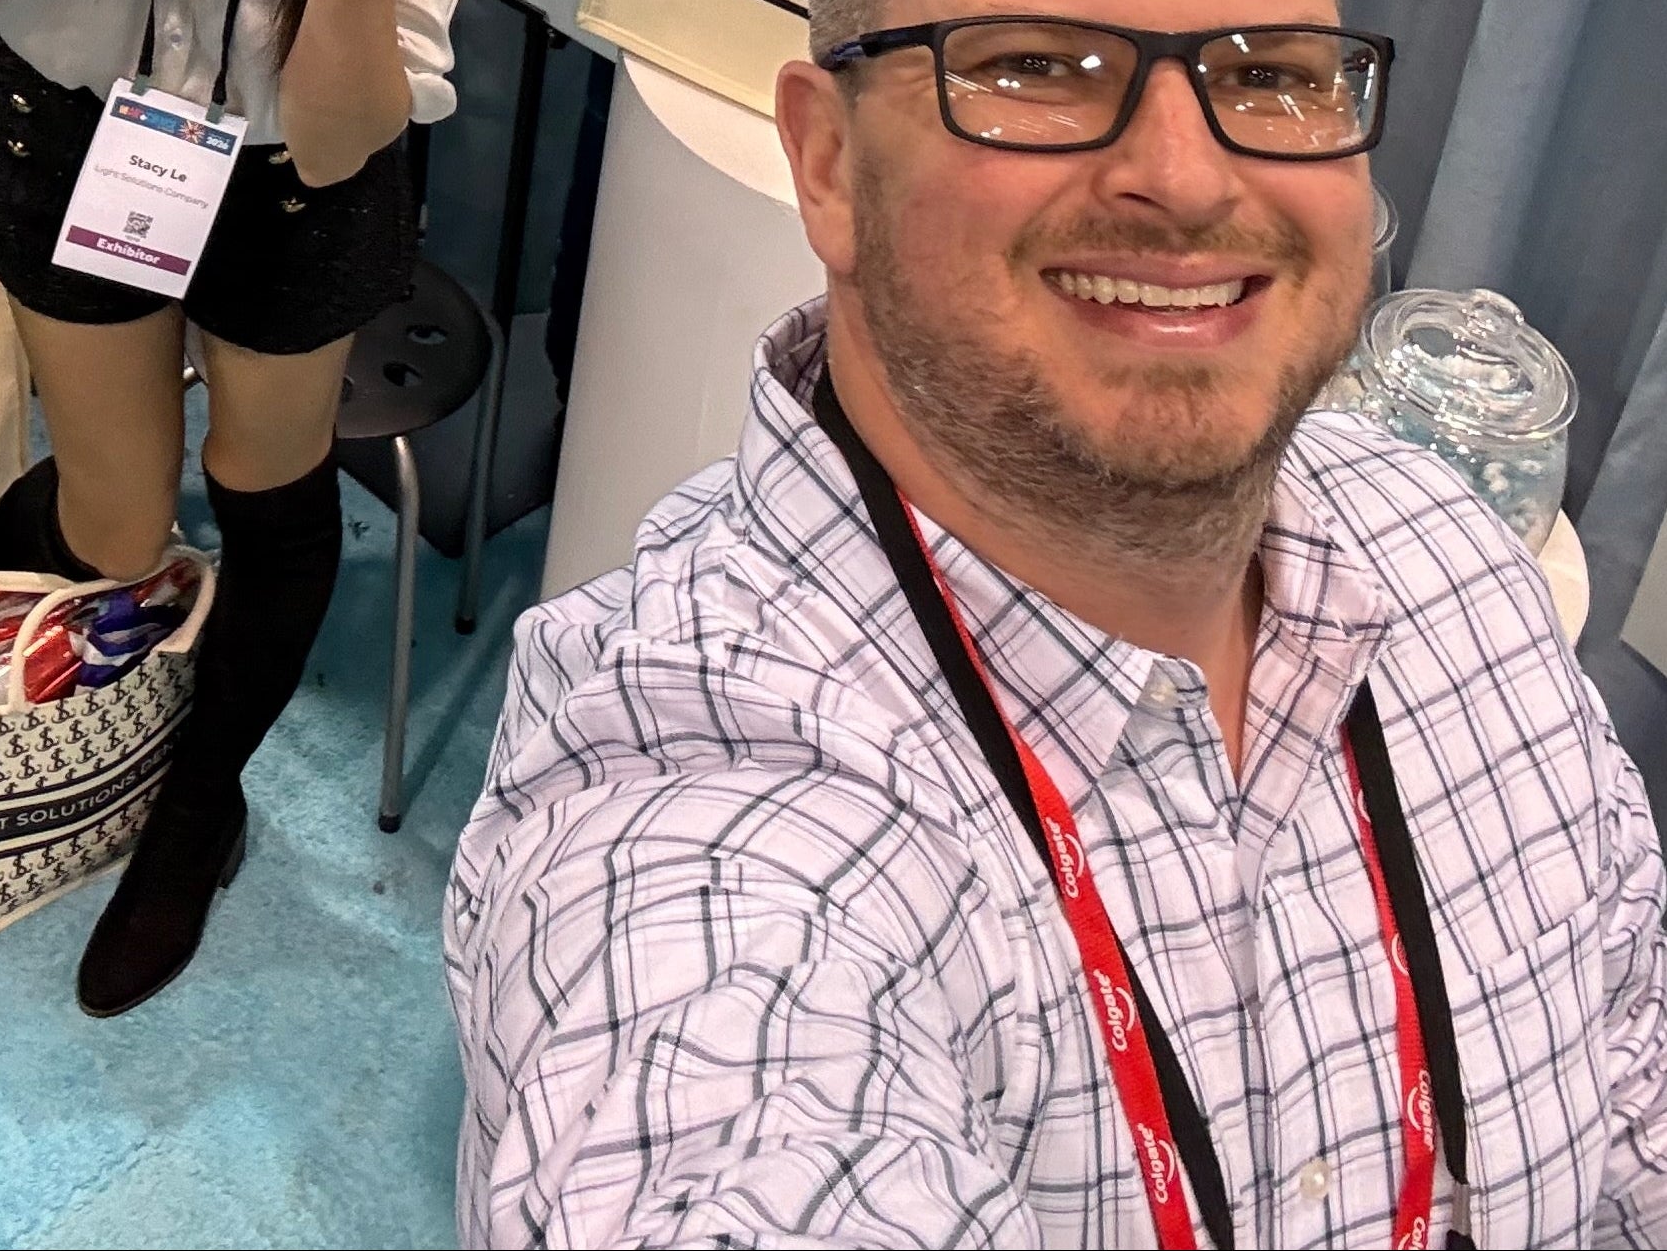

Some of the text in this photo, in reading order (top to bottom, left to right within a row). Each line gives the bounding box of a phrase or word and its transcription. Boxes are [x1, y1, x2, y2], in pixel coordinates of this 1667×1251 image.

[129, 154, 189, 184] Stacy Le
[97, 236, 162, 266] Exhibitor
[16, 771, 139, 828] SOLUTIONS
[1044, 816, 1081, 900] Colgate
[1092, 968, 1129, 1053] Colgate
[1138, 1121, 1170, 1205] Colgate
[1408, 1216, 1428, 1251] Col
